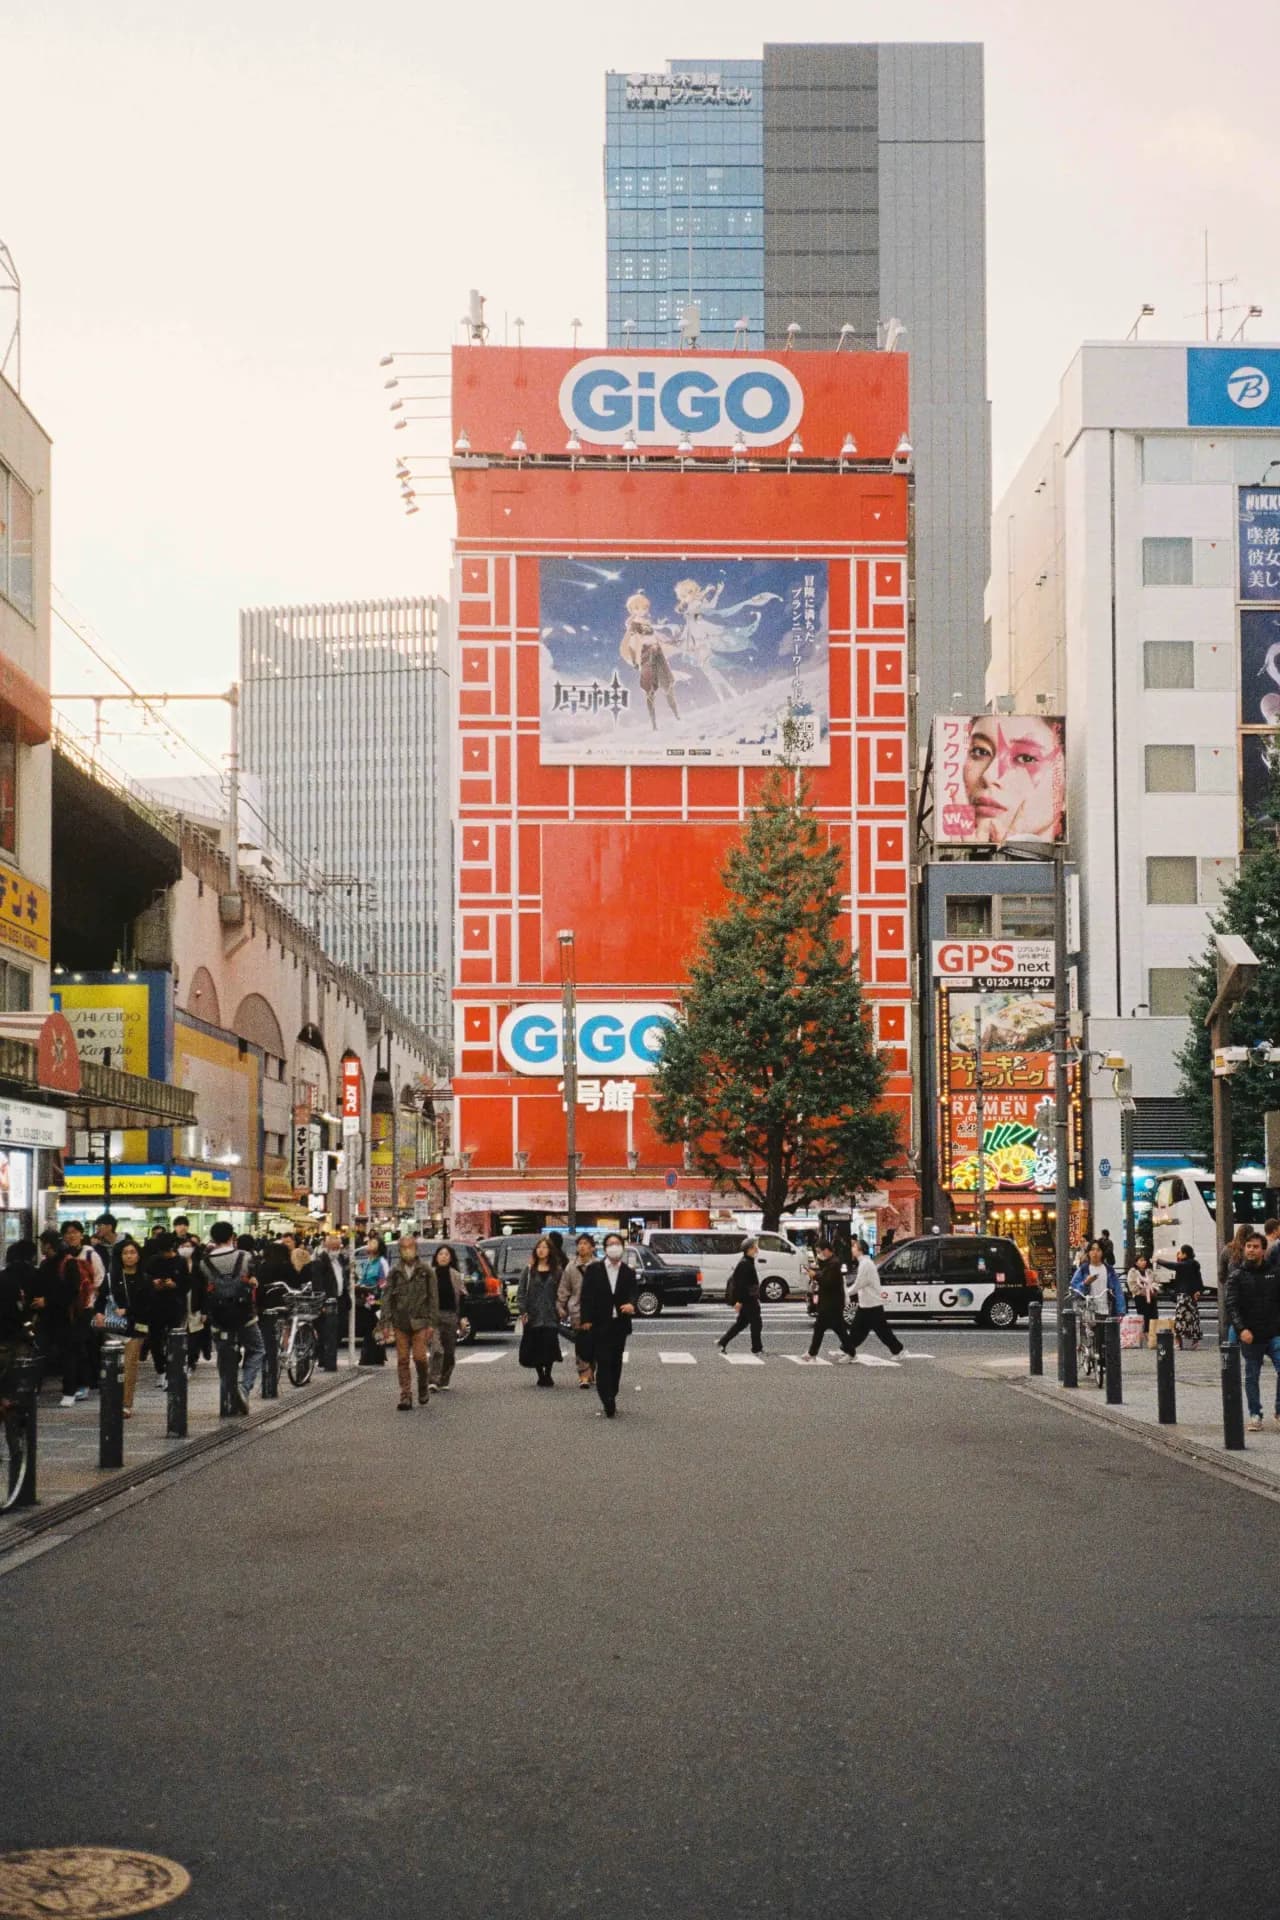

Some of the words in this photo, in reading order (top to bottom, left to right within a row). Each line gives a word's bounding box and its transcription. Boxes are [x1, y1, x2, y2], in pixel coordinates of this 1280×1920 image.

[571, 369, 790, 433] GiGO
[1247, 549, 1280, 567] 彼女
[1247, 570, 1280, 588] 美し
[552, 671, 628, 722] 原神
[943, 722, 960, 799] ワクワク
[937, 944, 1015, 973] GPS
[1017, 961, 1051, 972] next
[986, 977, 1050, 987] 0120-915-047
[346, 1086, 356, 1112] KFC
[952, 1101, 1027, 1115] RAMEN
[896, 1291, 926, 1303] TAXI
